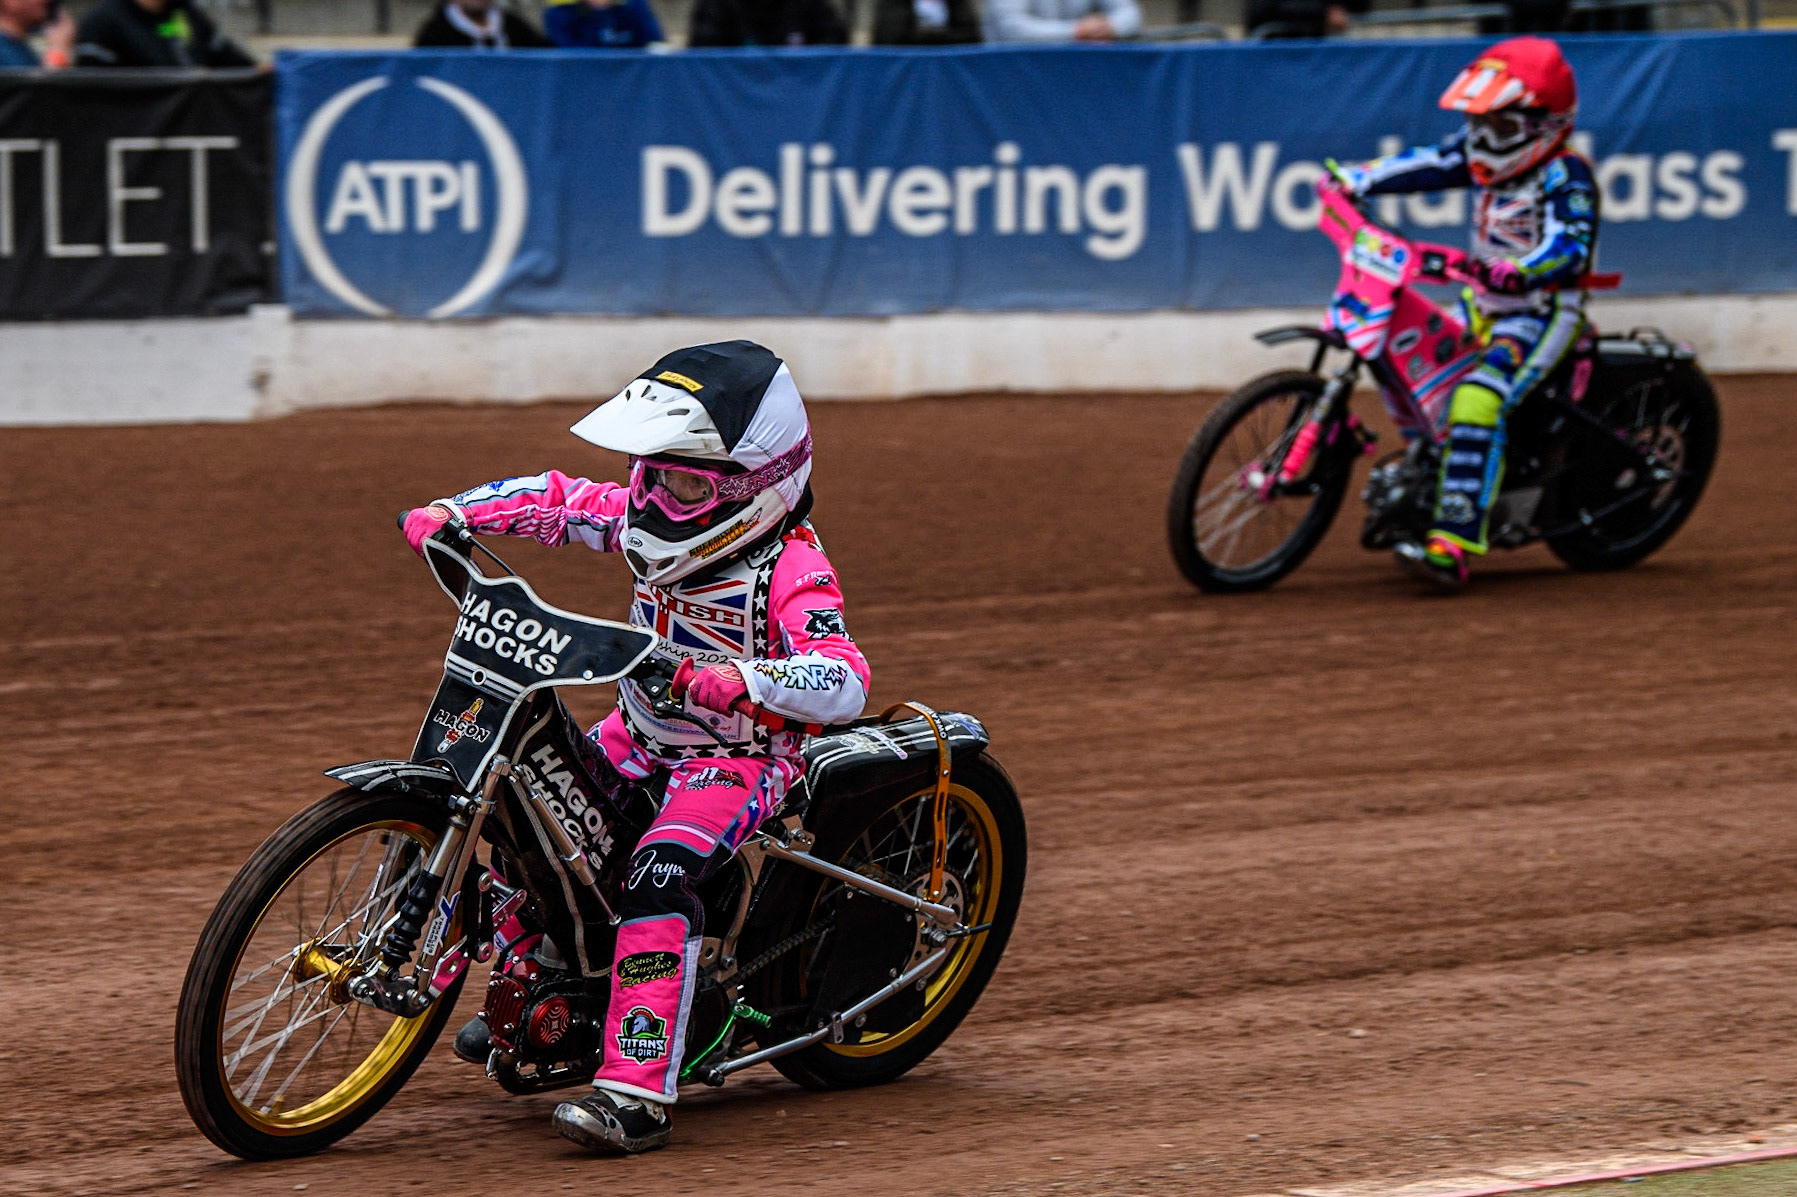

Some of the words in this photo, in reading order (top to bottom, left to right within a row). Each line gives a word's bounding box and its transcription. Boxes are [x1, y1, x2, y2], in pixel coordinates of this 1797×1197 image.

[325, 160, 480, 234] ATPI
[642, 142, 1147, 260] Delivering
[461, 591, 572, 655] HAGON
[697, 652, 740, 664] 202
[433, 708, 491, 743] HAGON
[530, 744, 614, 857] HAGON
[619, 967, 679, 989] Racing
[619, 1037, 665, 1051] TITANS
[637, 1048, 657, 1057] DIRT
